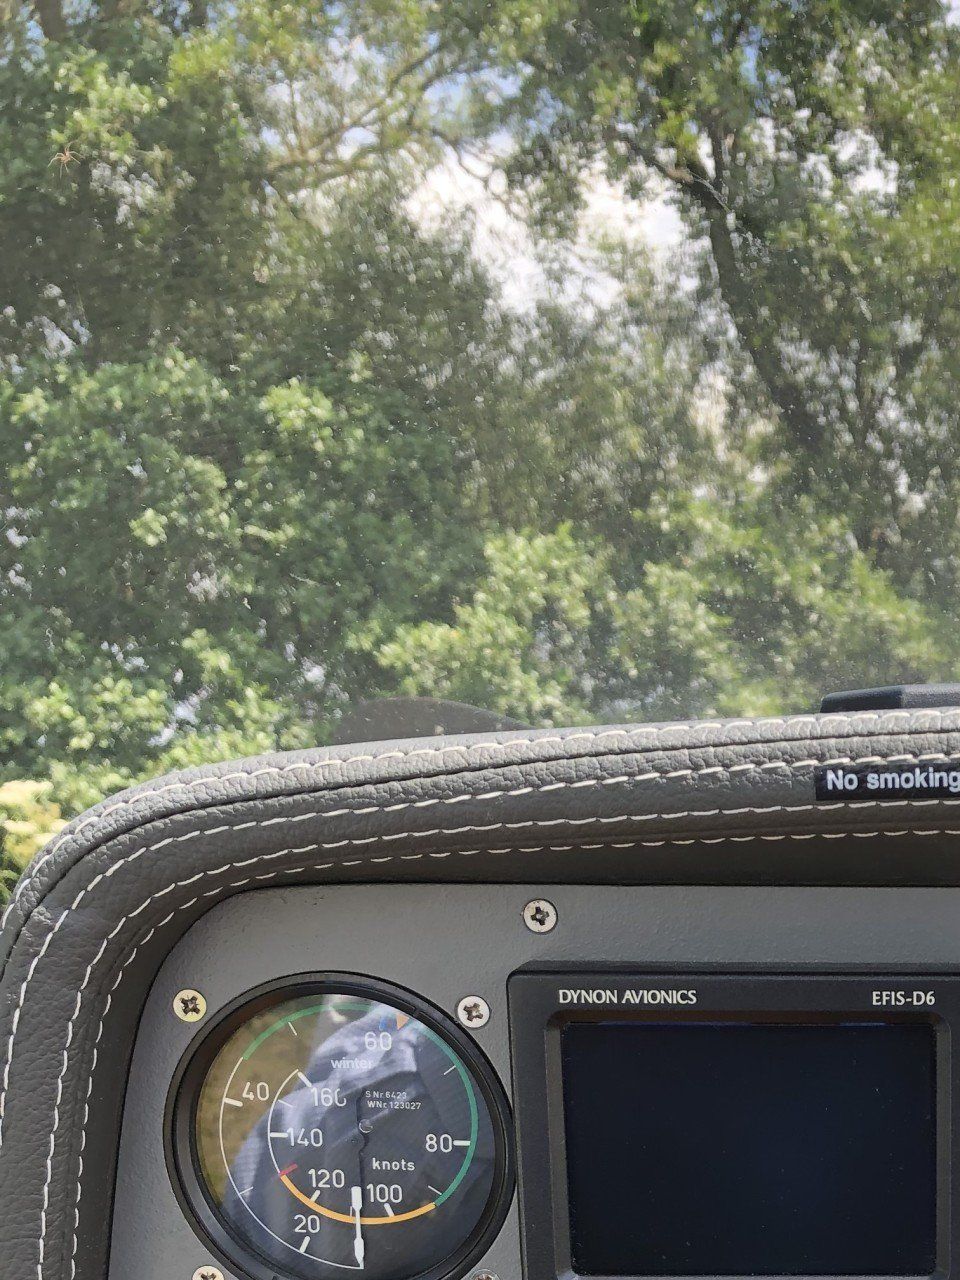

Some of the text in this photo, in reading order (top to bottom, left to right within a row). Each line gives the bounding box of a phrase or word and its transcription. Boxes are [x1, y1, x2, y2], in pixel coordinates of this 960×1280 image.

[826, 770, 858, 790] No
[559, 990, 697, 1005] DYNON AVIONICS
[872, 992, 935, 1006] EFIS-D6
[364, 1031, 392, 1050] 60
[331, 1057, 373, 1069] winter
[242, 1081, 269, 1102] 40
[311, 1087, 347, 1107] 160
[389, 1101, 422, 1110] 123027
[287, 1128, 323, 1147] 140
[425, 1133, 453, 1153] 80
[372, 1157, 415, 1172] knots
[308, 1169, 345, 1189] 120
[366, 1183, 403, 1203] 100
[294, 1214, 320, 1234] 20
